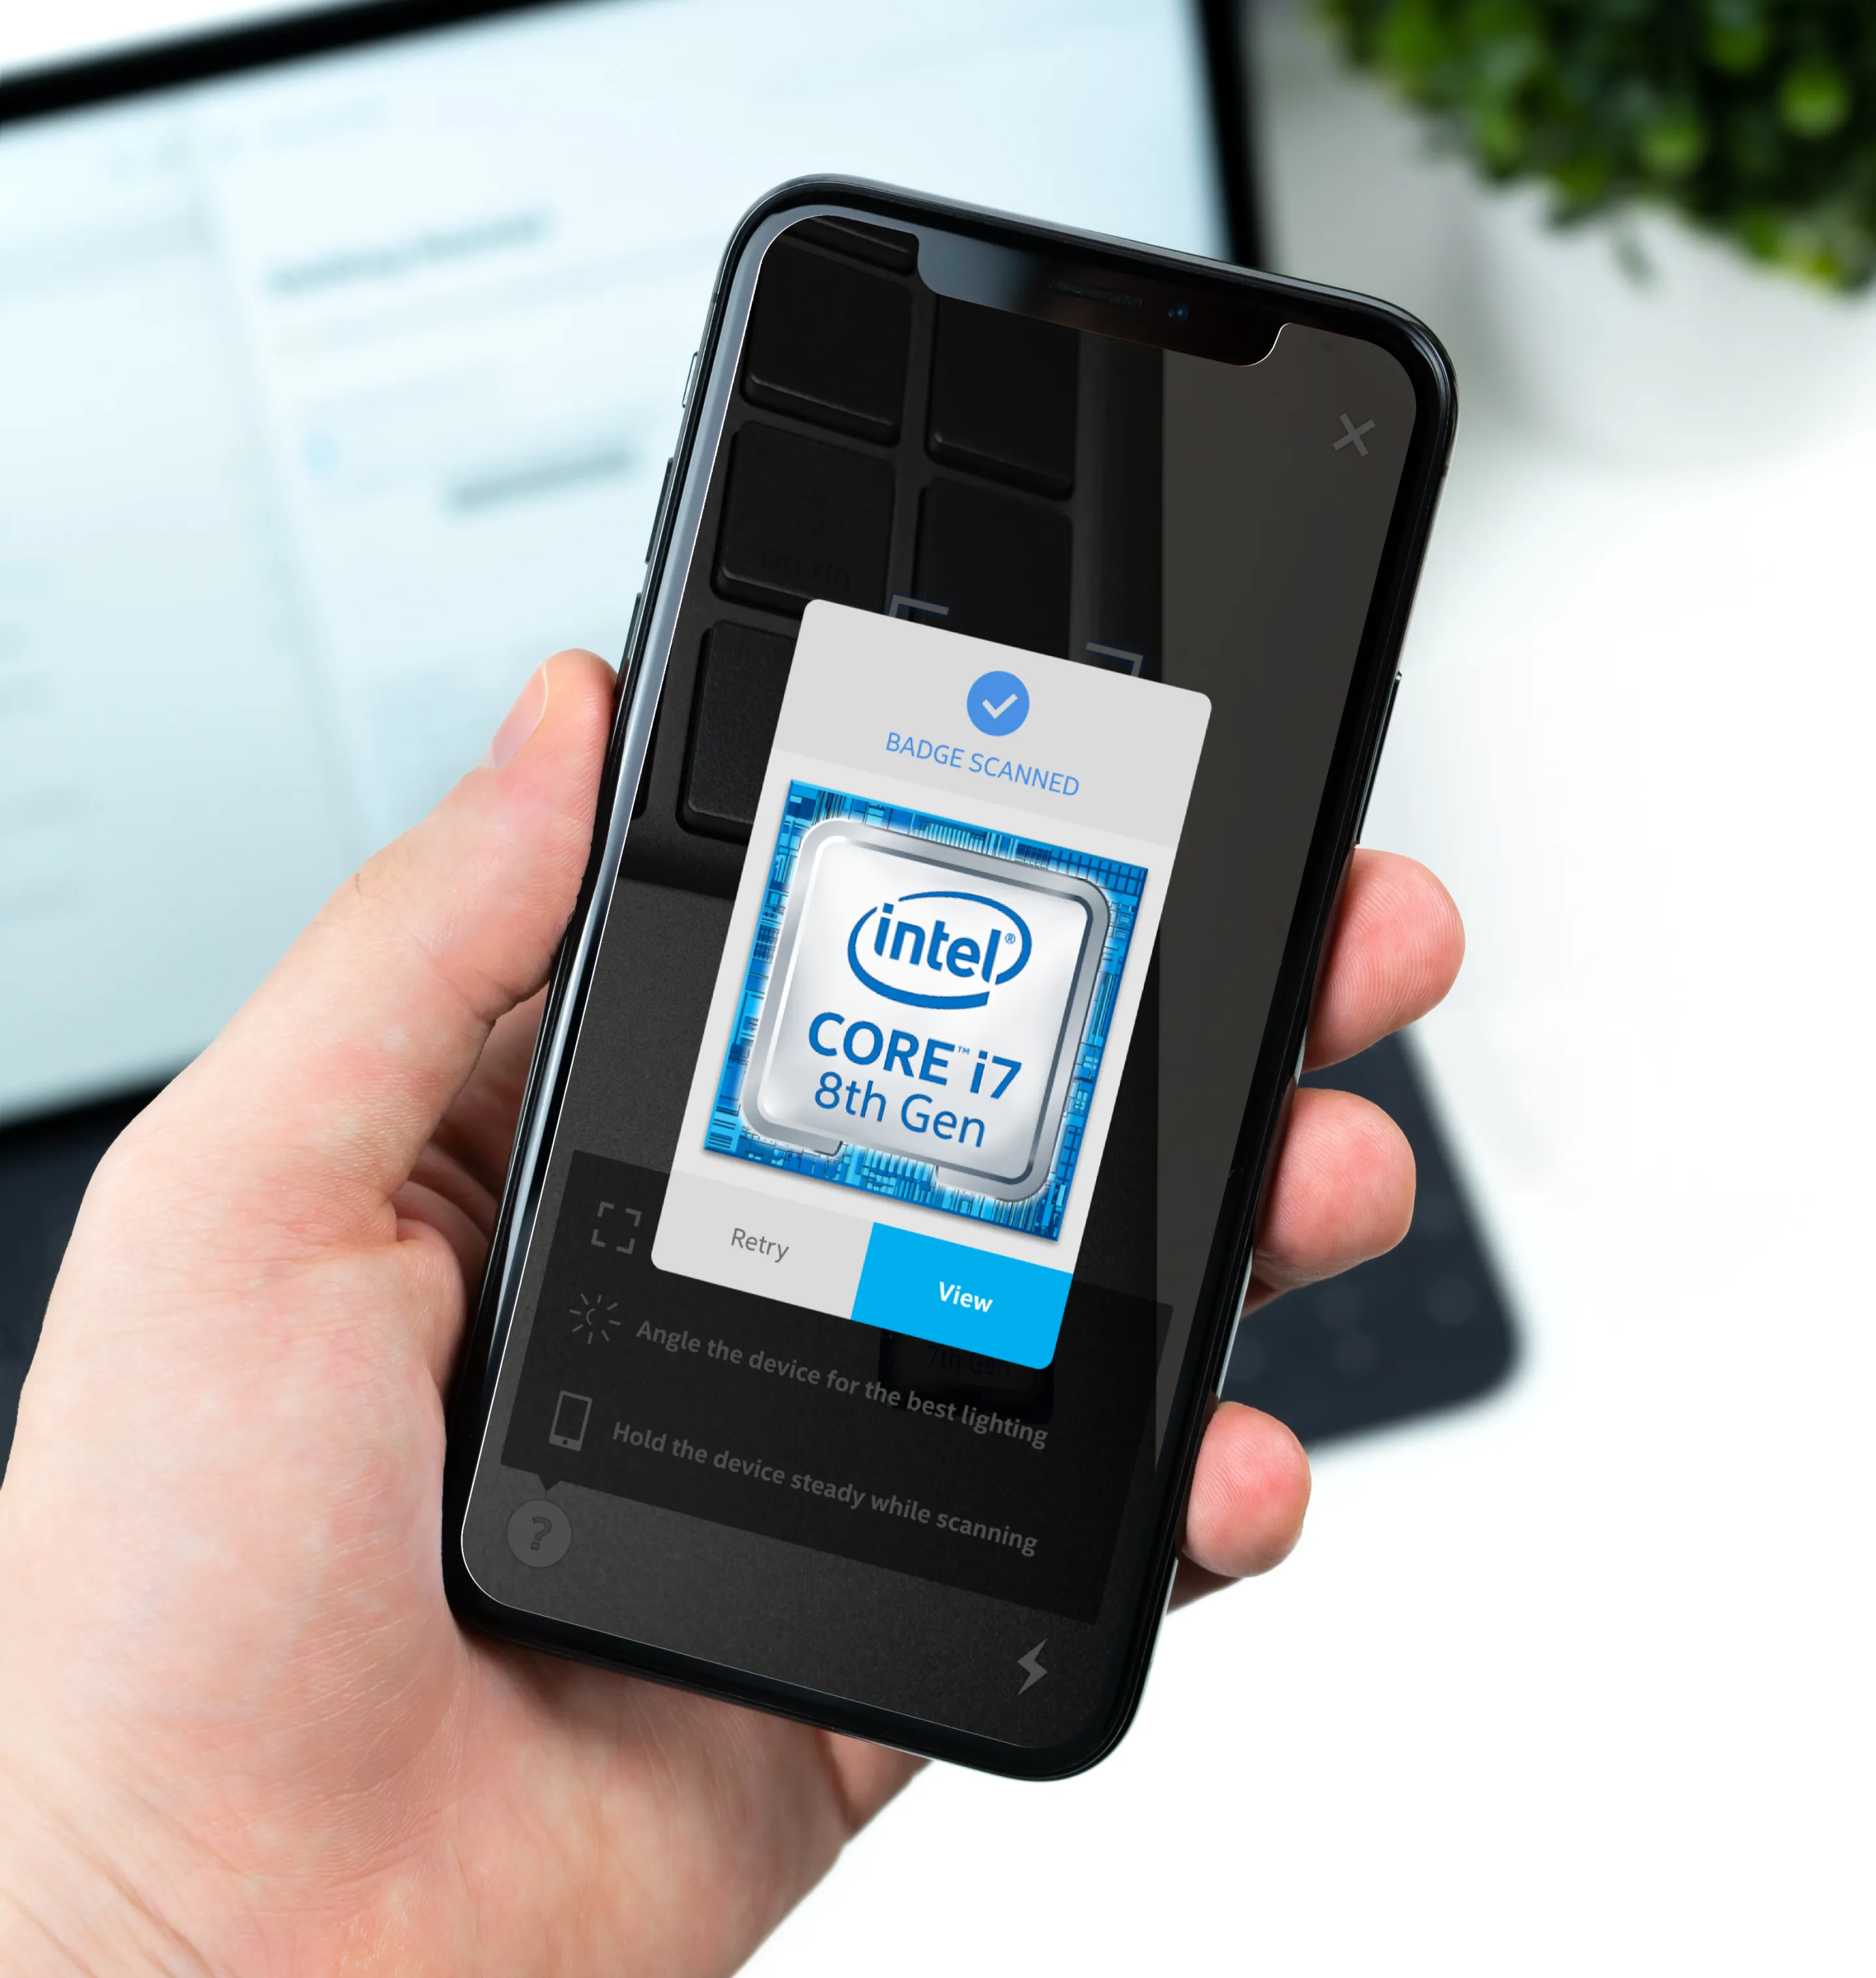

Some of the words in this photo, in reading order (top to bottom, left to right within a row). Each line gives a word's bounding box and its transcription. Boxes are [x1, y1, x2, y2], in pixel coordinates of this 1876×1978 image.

[885, 731, 965, 769] BADGE
[969, 752, 1079, 796] SCANNED
[970, 1050, 1022, 1100] i7
[814, 1071, 887, 1123] 8th
[901, 1093, 985, 1147] Gen
[730, 1227, 790, 1263] Retry
[939, 1281, 993, 1312] View
[635, 1320, 701, 1353] Angle
[707, 1339, 743, 1364] the
[748, 1350, 821, 1384] device
[827, 1369, 860, 1394] for
[865, 1381, 901, 1406] the
[907, 1390, 956, 1421] best
[961, 1405, 1048, 1450] lighting
[927, 1345, 961, 1371] 7th
[612, 1421, 667, 1453] Hold
[672, 1439, 708, 1464] the
[713, 1450, 785, 1484] device
[790, 1474, 866, 1510] steady
[871, 1495, 931, 1524] while
[935, 1513, 1038, 1557] scanning
